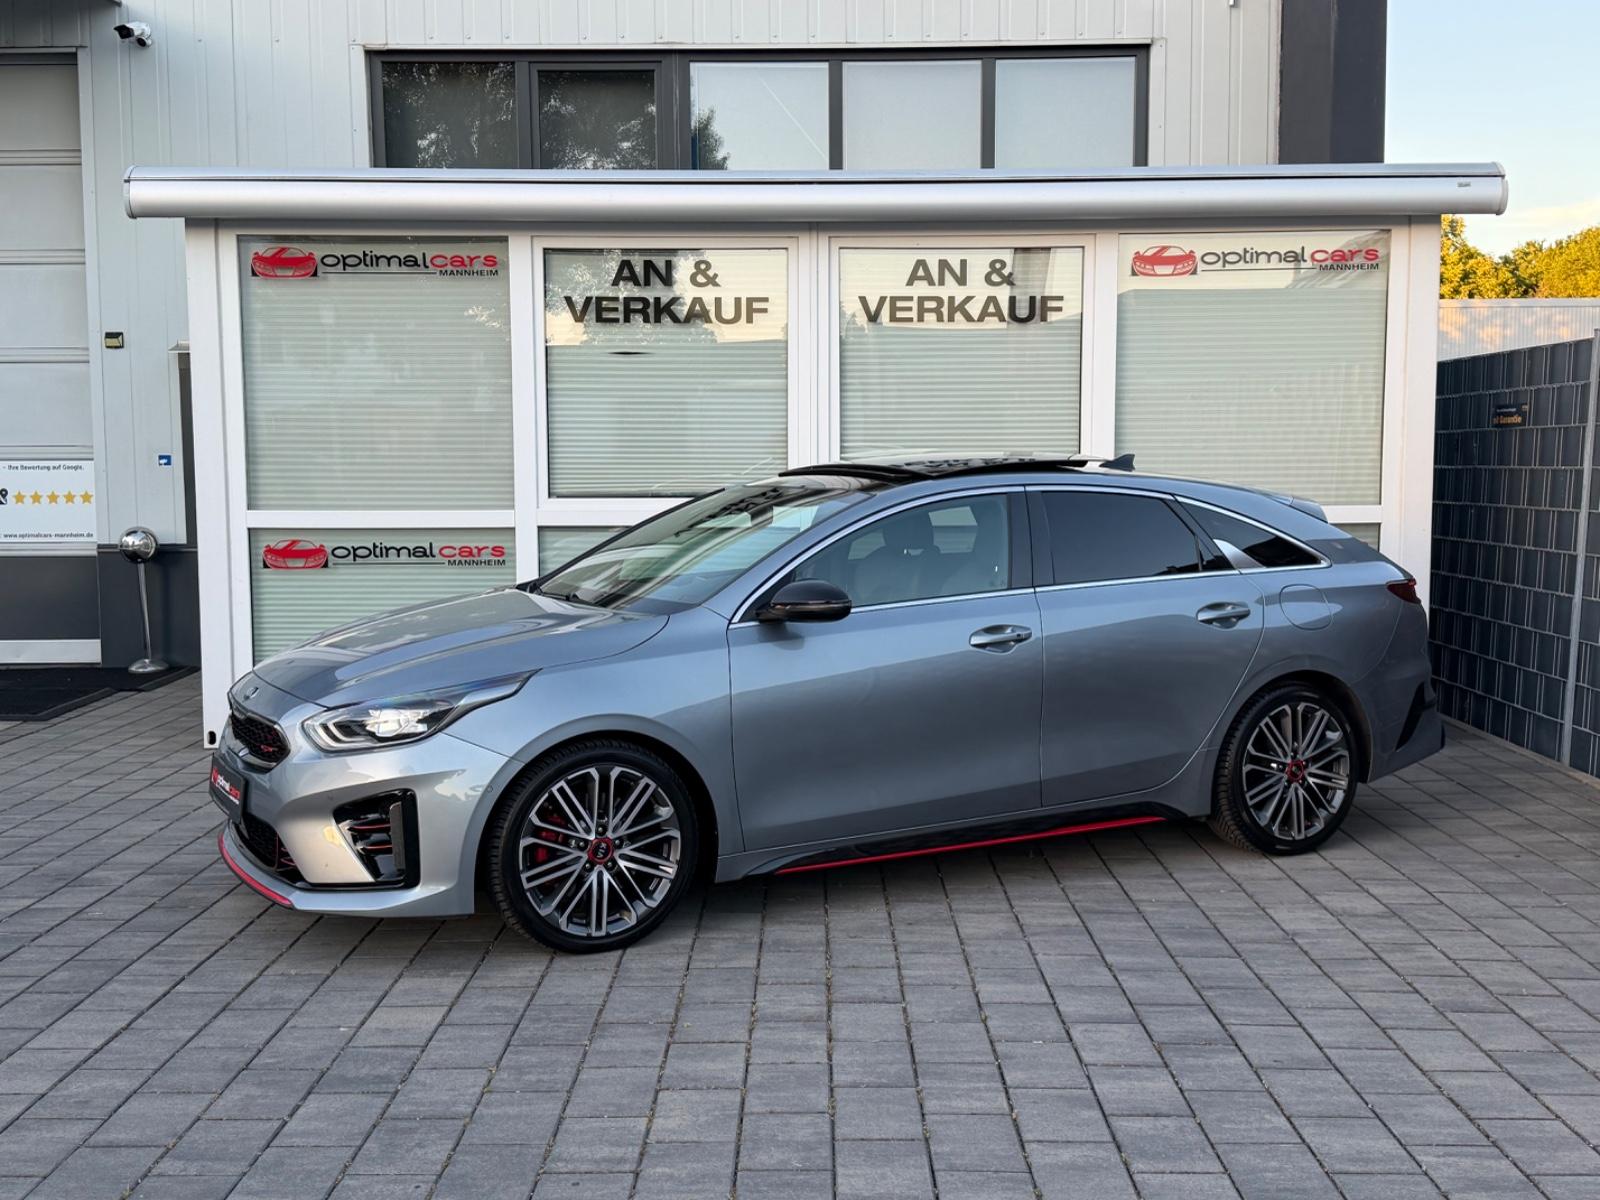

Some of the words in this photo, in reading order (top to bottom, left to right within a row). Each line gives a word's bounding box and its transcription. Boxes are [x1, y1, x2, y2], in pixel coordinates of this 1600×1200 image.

[439, 269, 498, 277] MANNHEIM
[612, 259, 673, 287] AN
[689, 259, 721, 287] &
[905, 258, 968, 287] AN
[984, 258, 1016, 287] &
[1319, 263, 1379, 271] MANNHEIM
[565, 296, 769, 324] VERKAUF
[859, 295, 1064, 323] VERKAUF
[20, 464, 51, 472] Bewertung
